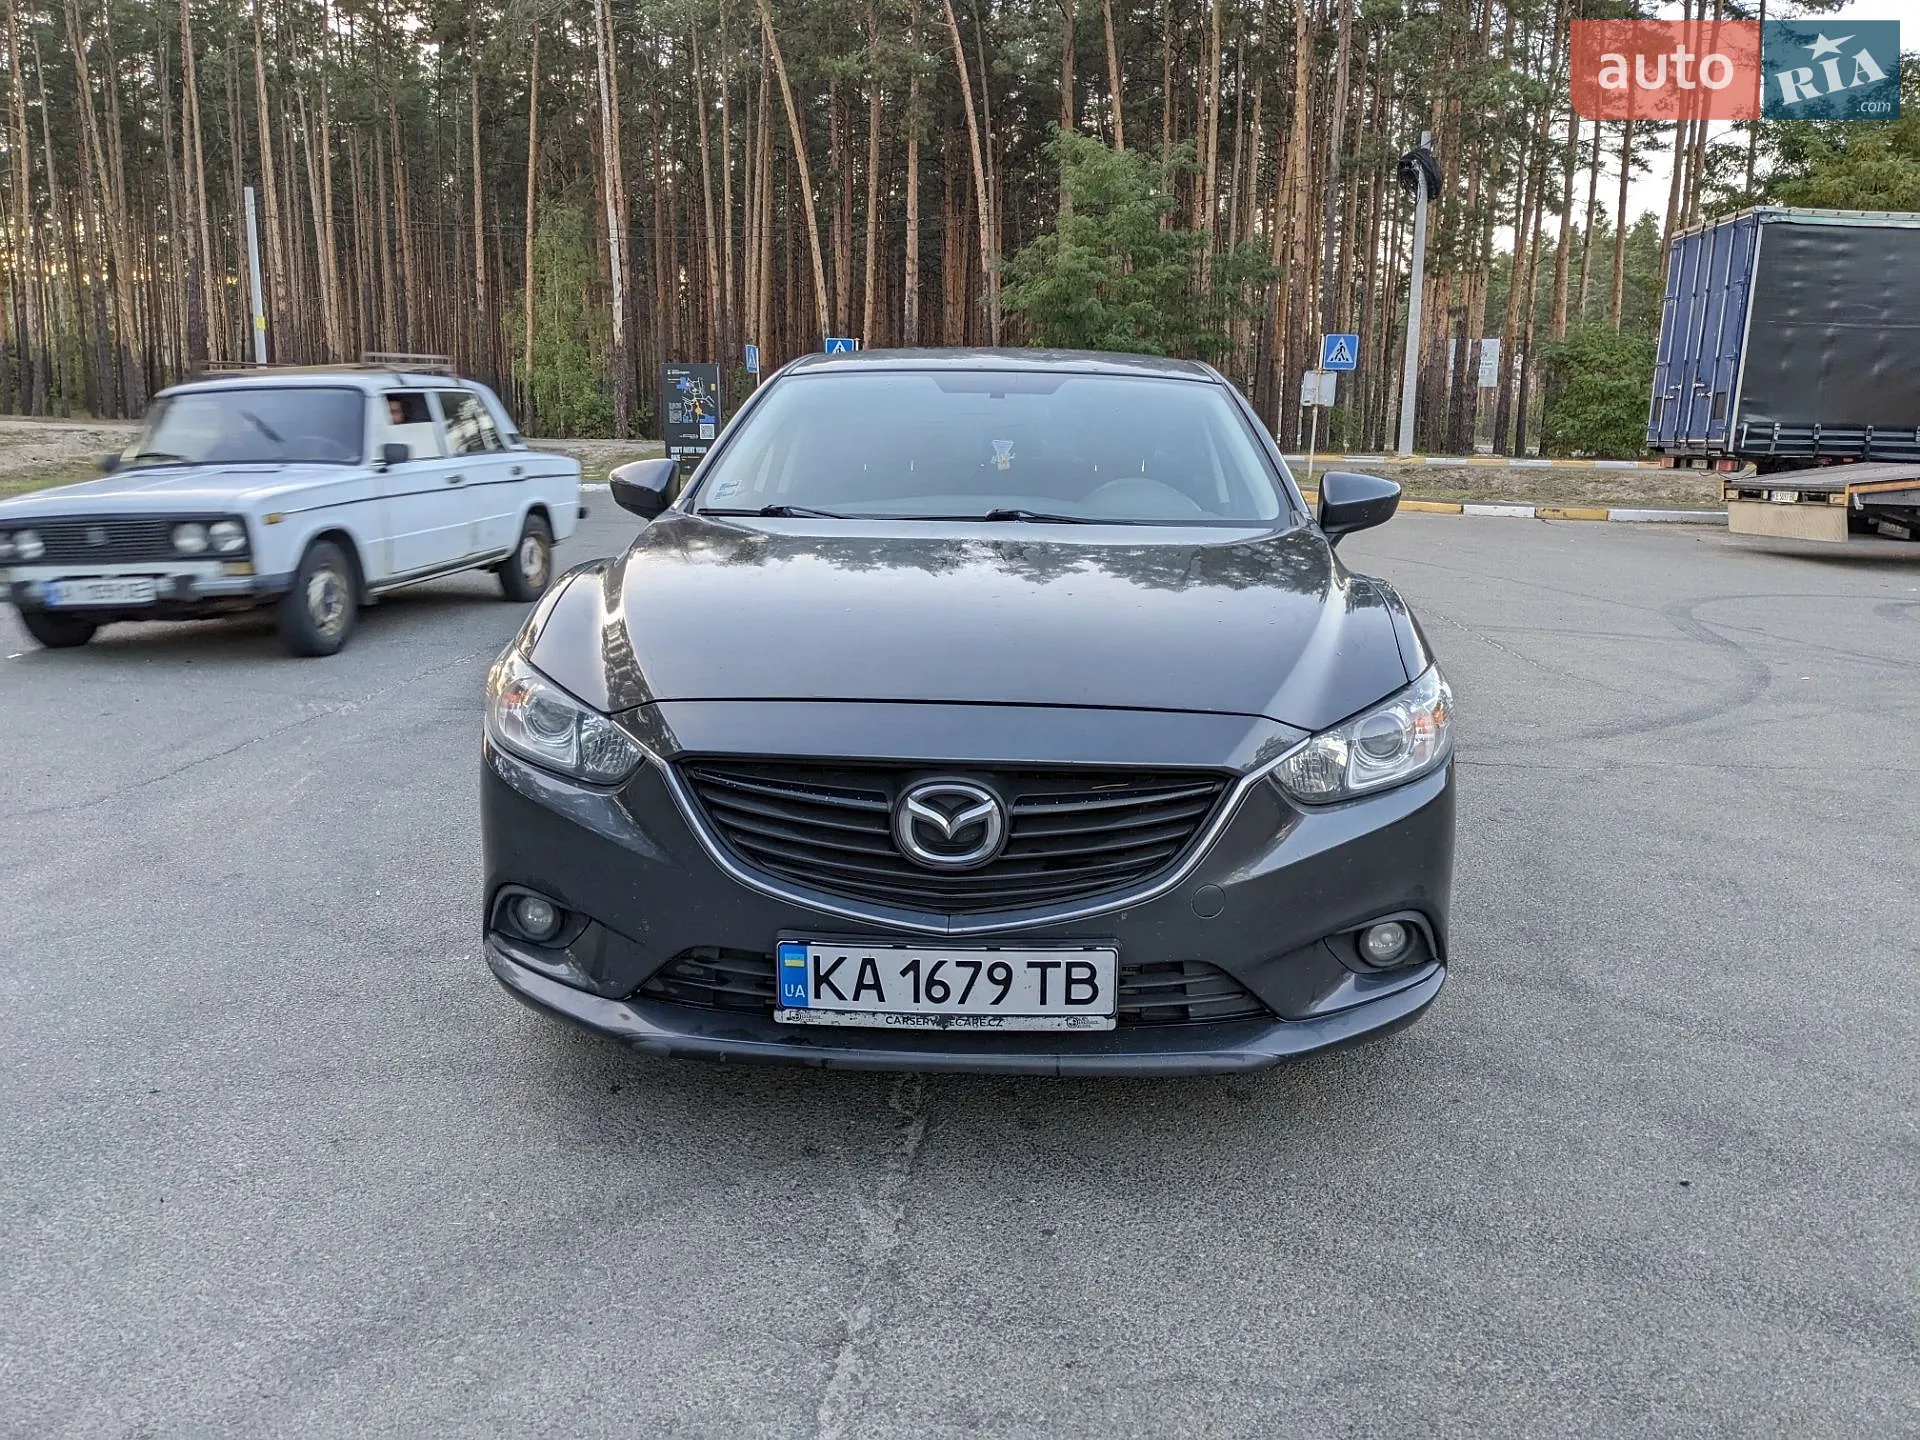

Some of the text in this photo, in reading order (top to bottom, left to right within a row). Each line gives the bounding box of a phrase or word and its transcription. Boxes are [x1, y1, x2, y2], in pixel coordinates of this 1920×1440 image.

[784, 984, 806, 998] UA
[812, 955, 1099, 1006] KA 1679 TB
